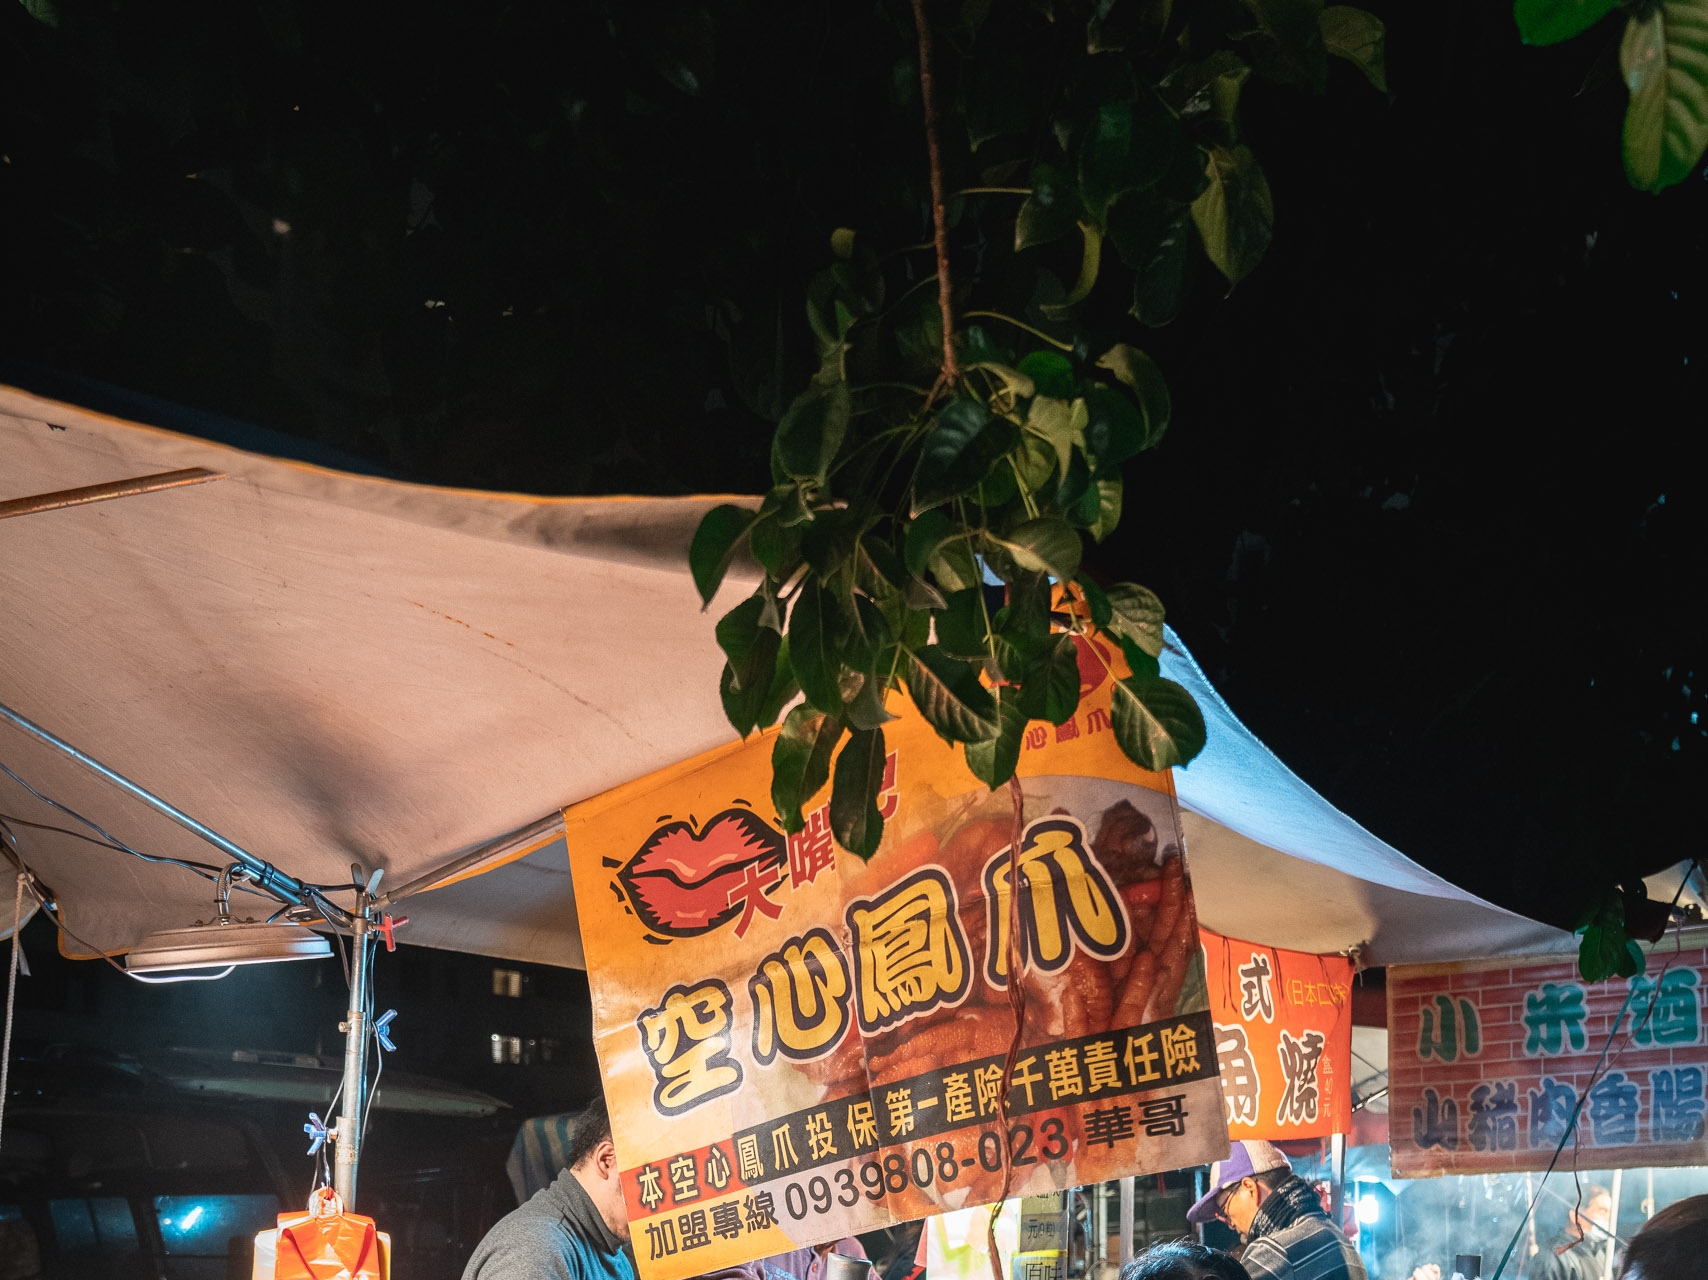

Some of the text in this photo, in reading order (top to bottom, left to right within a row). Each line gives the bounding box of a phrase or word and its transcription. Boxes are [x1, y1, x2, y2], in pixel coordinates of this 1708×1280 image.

[638, 818, 1128, 1117] 空心鳳爪
[1418, 968, 1700, 1062] 小米酒
[637, 1023, 1202, 1211] 本空心鳳爪投保第一產險千萬責任險
[646, 1093, 1188, 1262] 加盟專線 0939808-023 華哥
